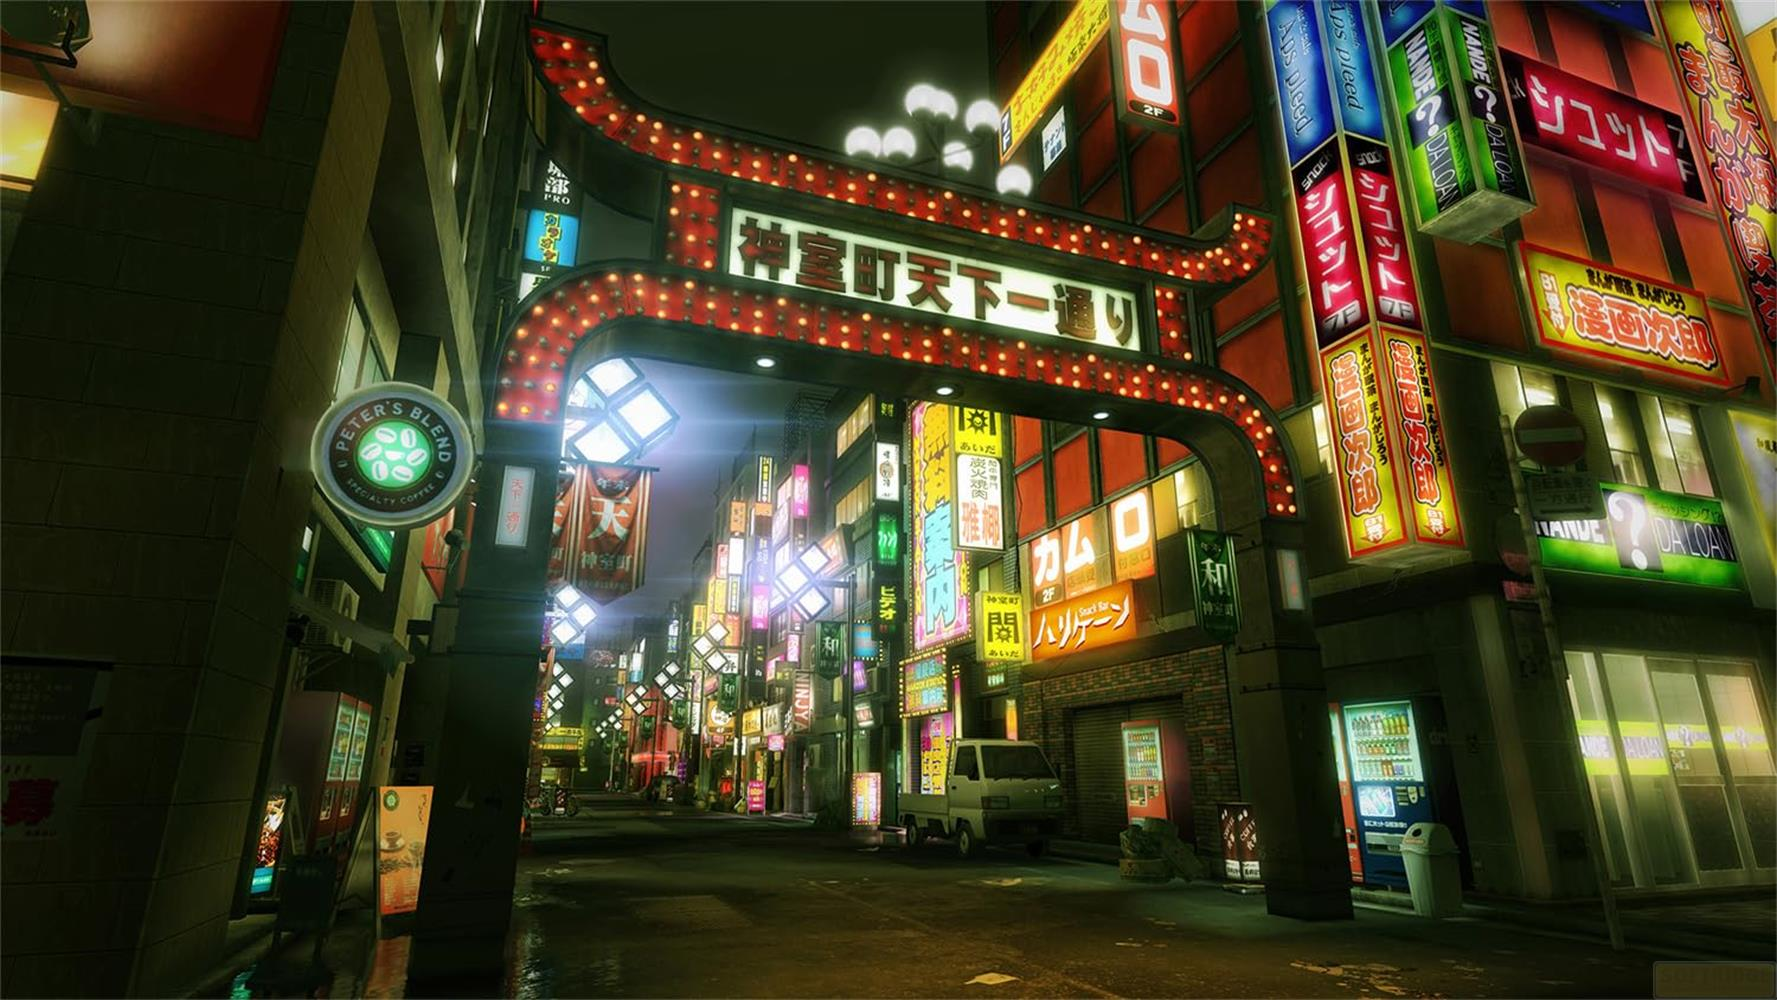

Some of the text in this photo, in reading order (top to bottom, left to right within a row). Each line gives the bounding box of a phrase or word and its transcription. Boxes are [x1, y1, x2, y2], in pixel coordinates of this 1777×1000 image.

[1405, 29, 1437, 102] NANDE
[1461, 20, 1490, 85] NANDE
[1143, 104, 1165, 117] 2F
[1416, 94, 1442, 137] ?
[1474, 86, 1498, 123] ?
[1667, 124, 1696, 182] 7F
[544, 195, 570, 205] PRO
[739, 217, 1134, 345] 神室町天下一通り
[1324, 304, 1358, 331] 7F
[1382, 297, 1411, 320] 7F
[1567, 285, 1719, 370] 漫画次郎
[336, 400, 452, 463] PETER'S BLEND
[1331, 351, 1380, 516] 漫画次郎
[1389, 341, 1440, 506] 漫画次郎
[960, 442, 997, 455] あいだ
[347, 478, 436, 505] SPECIALTY COFFEE
[970, 458, 989, 501] 炭火焼肉
[587, 496, 632, 541] 天
[1042, 587, 1055, 603] 2F
[1201, 557, 1232, 596] 和
[879, 585, 897, 621] ビデオ
[986, 595, 1020, 606] 神室町
[1033, 594, 1130, 649] ハリケーン
[988, 649, 1020, 658] あいだ
